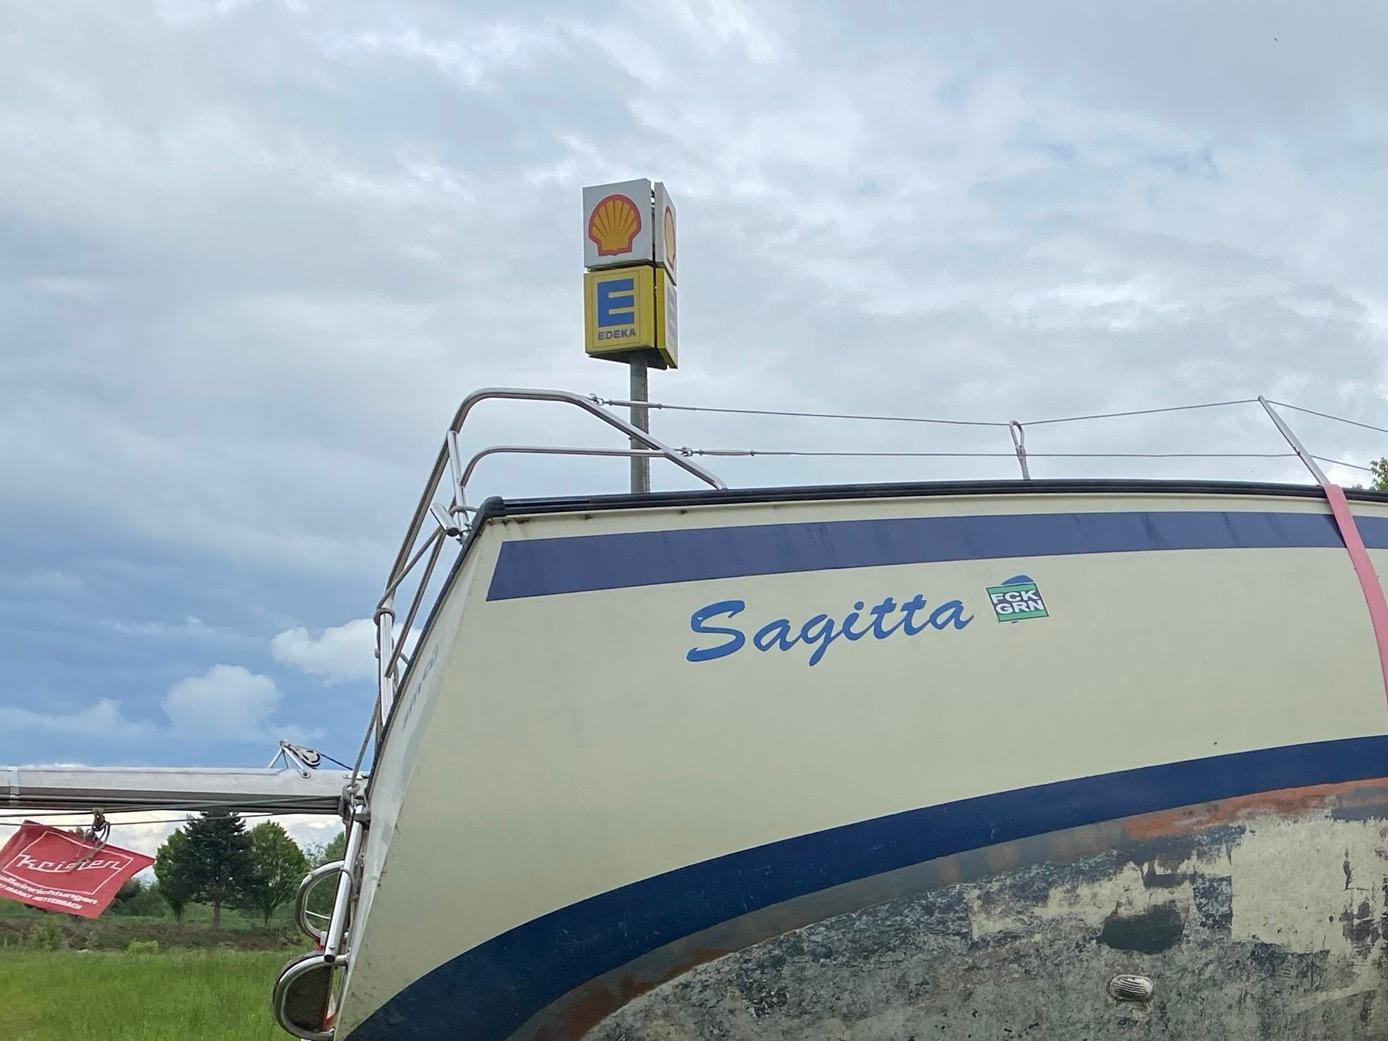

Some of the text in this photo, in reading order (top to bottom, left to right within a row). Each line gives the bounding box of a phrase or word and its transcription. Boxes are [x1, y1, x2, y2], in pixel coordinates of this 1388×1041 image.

[597, 278, 635, 328] E
[597, 328, 637, 341] EDEKA
[990, 590, 1041, 604] FCK
[995, 600, 1045, 614] GRN
[686, 594, 974, 667] Sagitta
